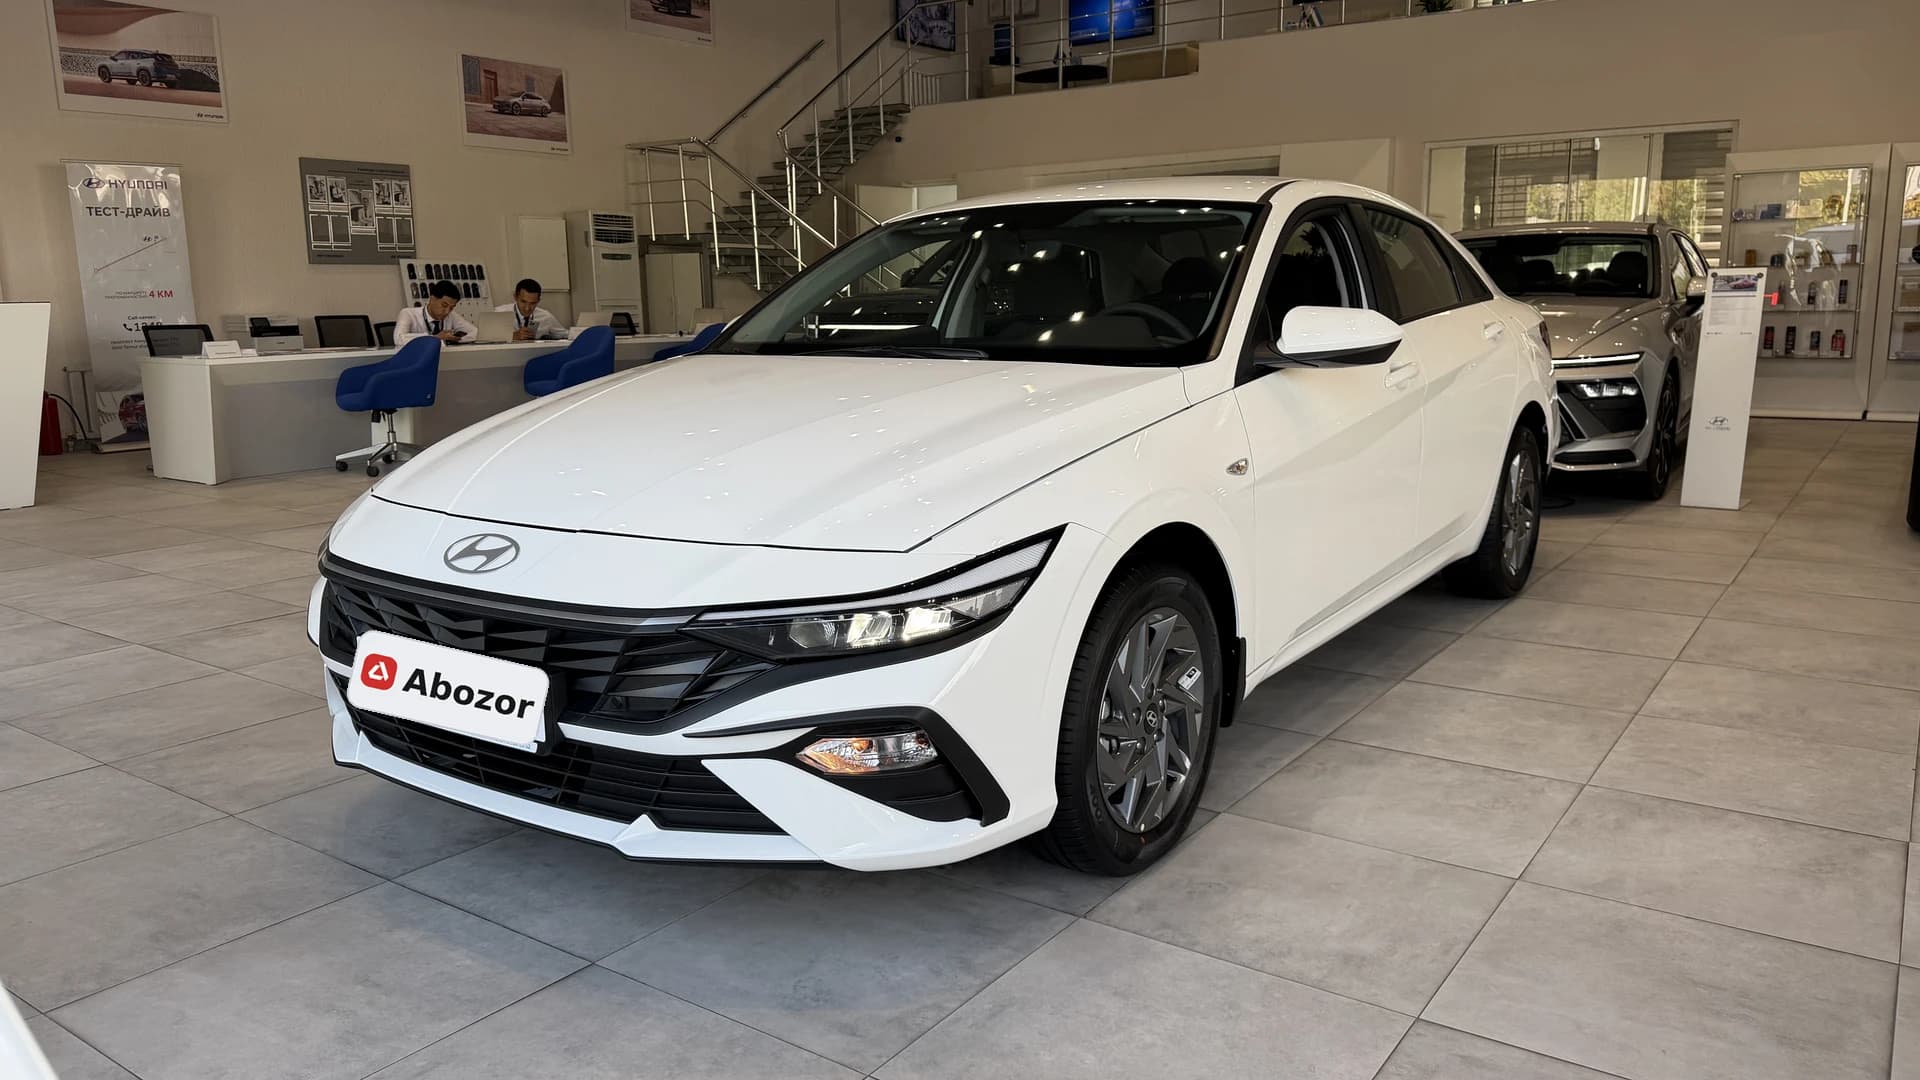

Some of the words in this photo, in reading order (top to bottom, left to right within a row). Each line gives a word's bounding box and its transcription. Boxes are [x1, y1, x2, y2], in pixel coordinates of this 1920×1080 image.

[108, 179, 168, 190] HYUNDAI
[86, 205, 171, 218] ТЕСТ-ДРАЙВ
[149, 290, 155, 298] 4
